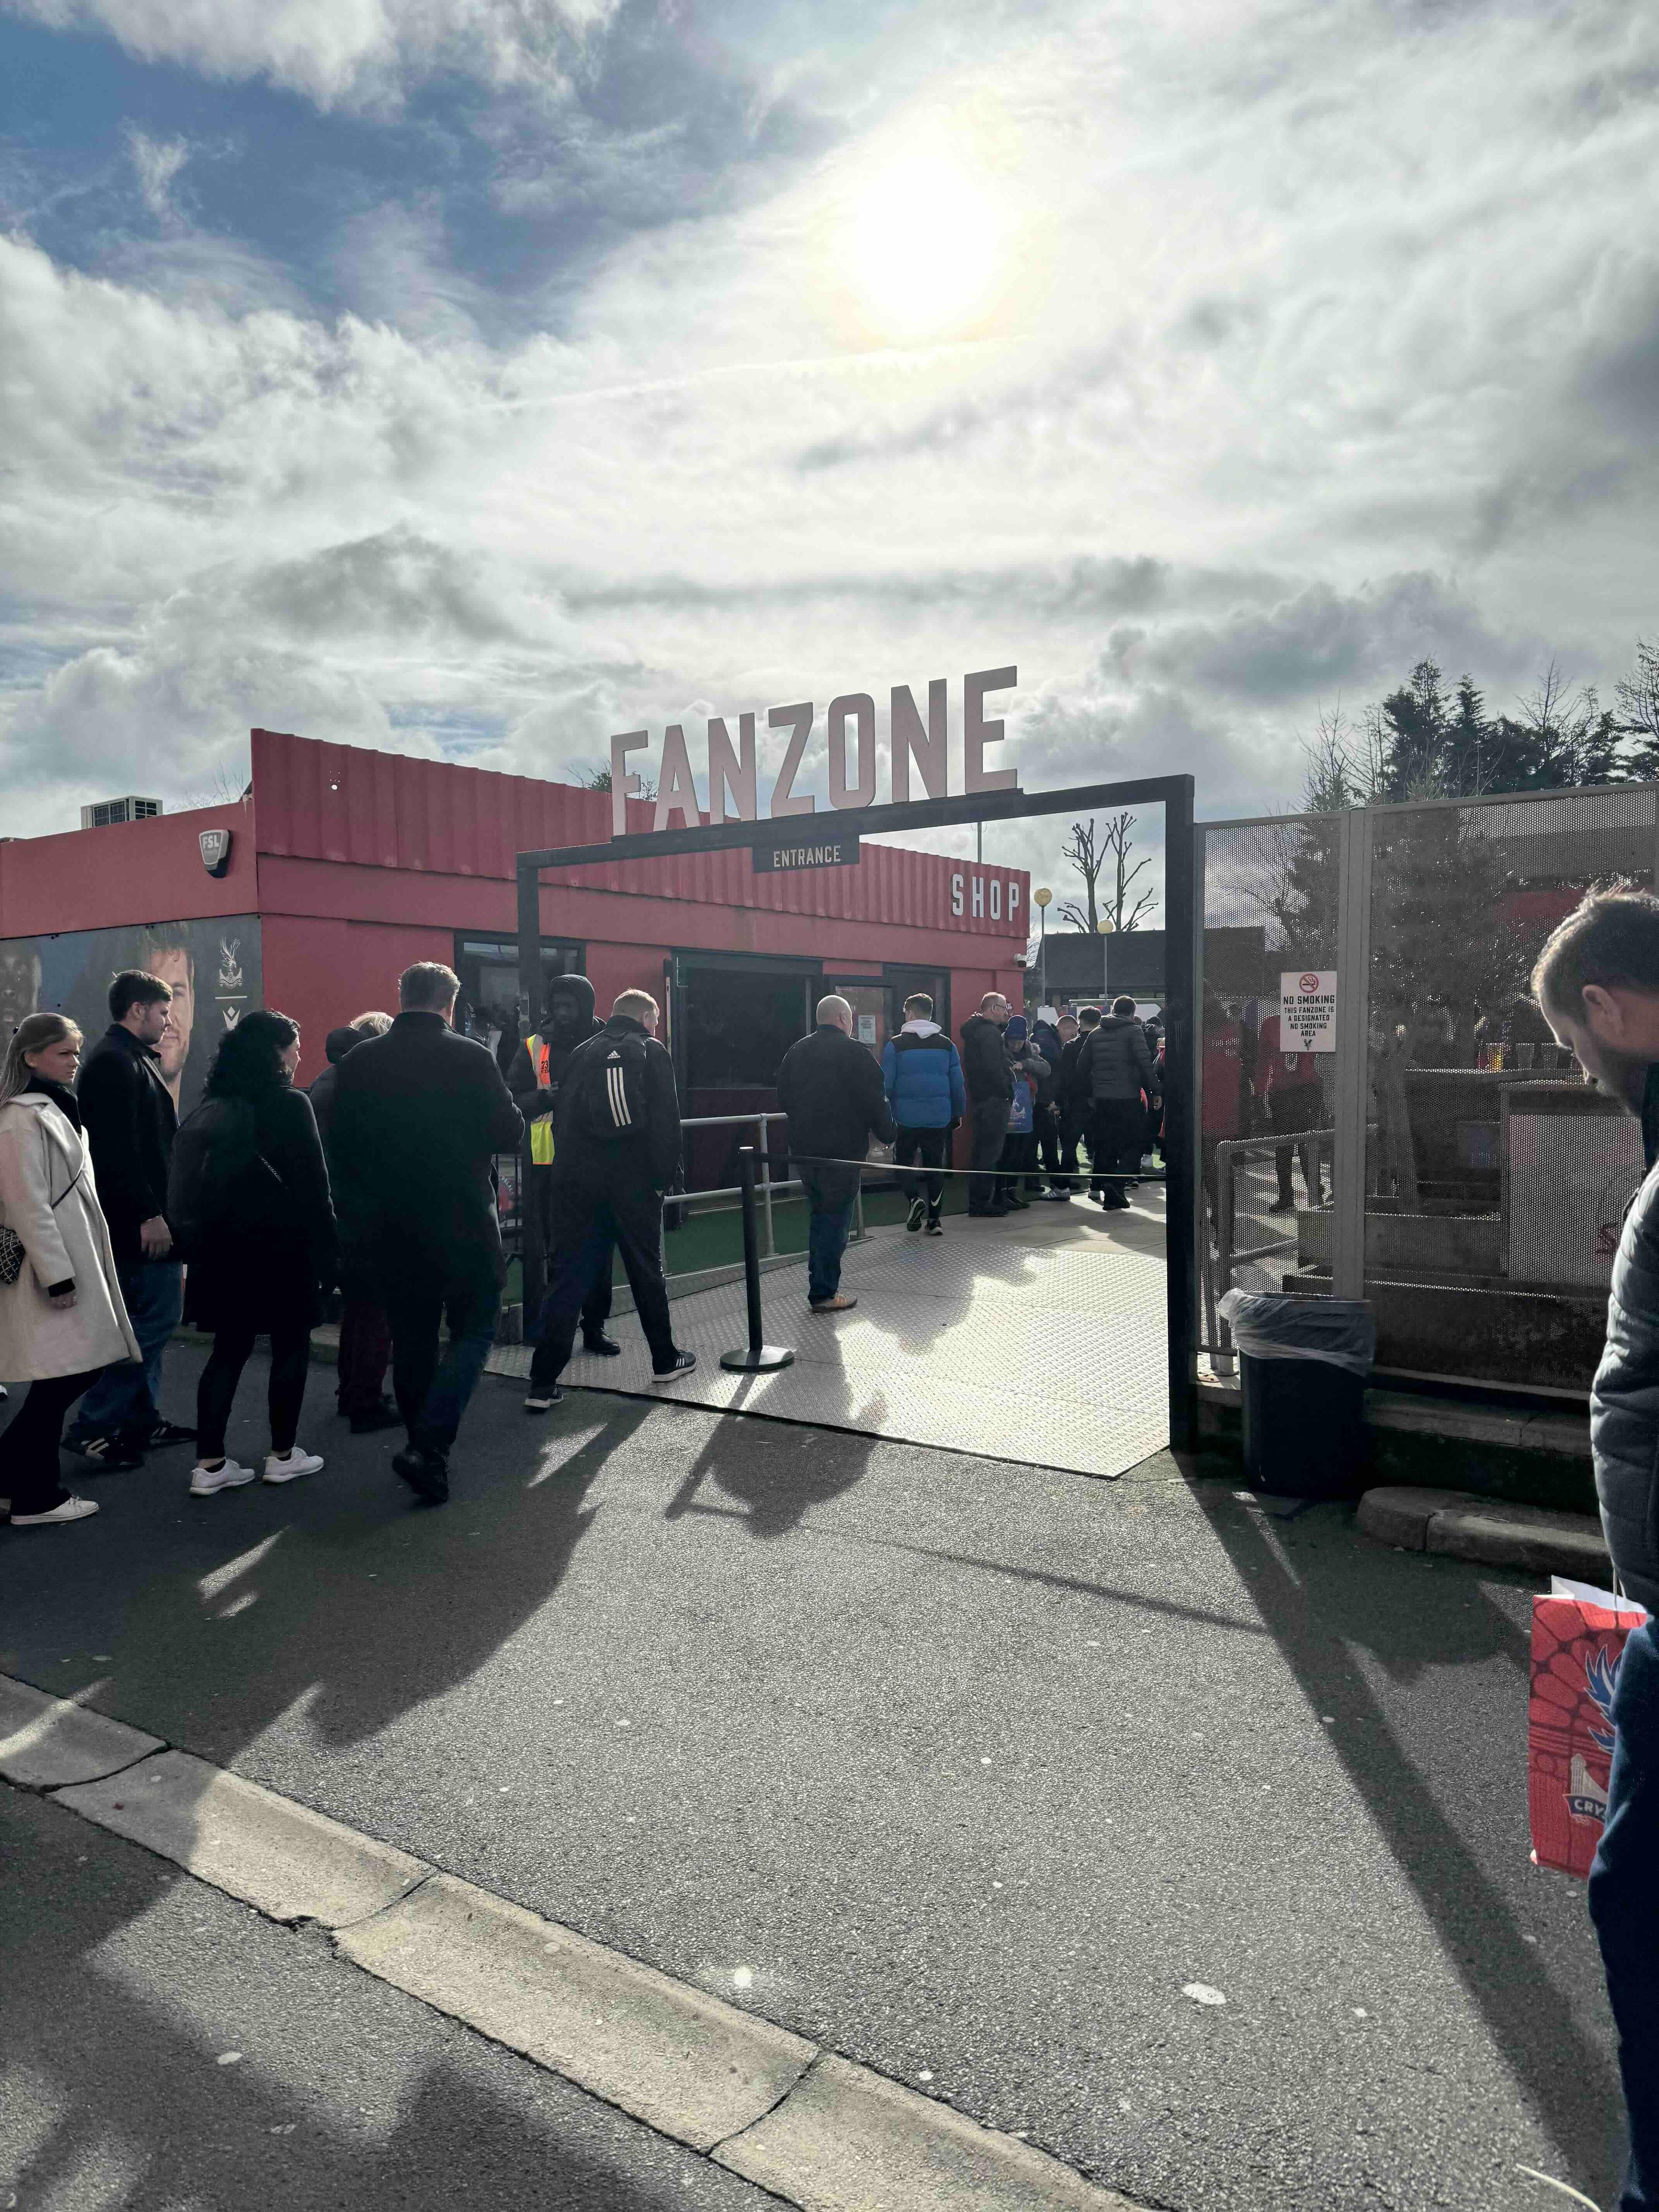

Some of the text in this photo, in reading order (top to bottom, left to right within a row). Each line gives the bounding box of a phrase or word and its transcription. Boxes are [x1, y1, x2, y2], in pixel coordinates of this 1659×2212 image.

[611, 665, 1017, 836] FANZONE
[203, 835, 219, 849] FSL
[774, 845, 841, 867] ENTRANCE
[952, 874, 1019, 922] SHOP
[1284, 995, 1335, 1004] NO SMOKING
